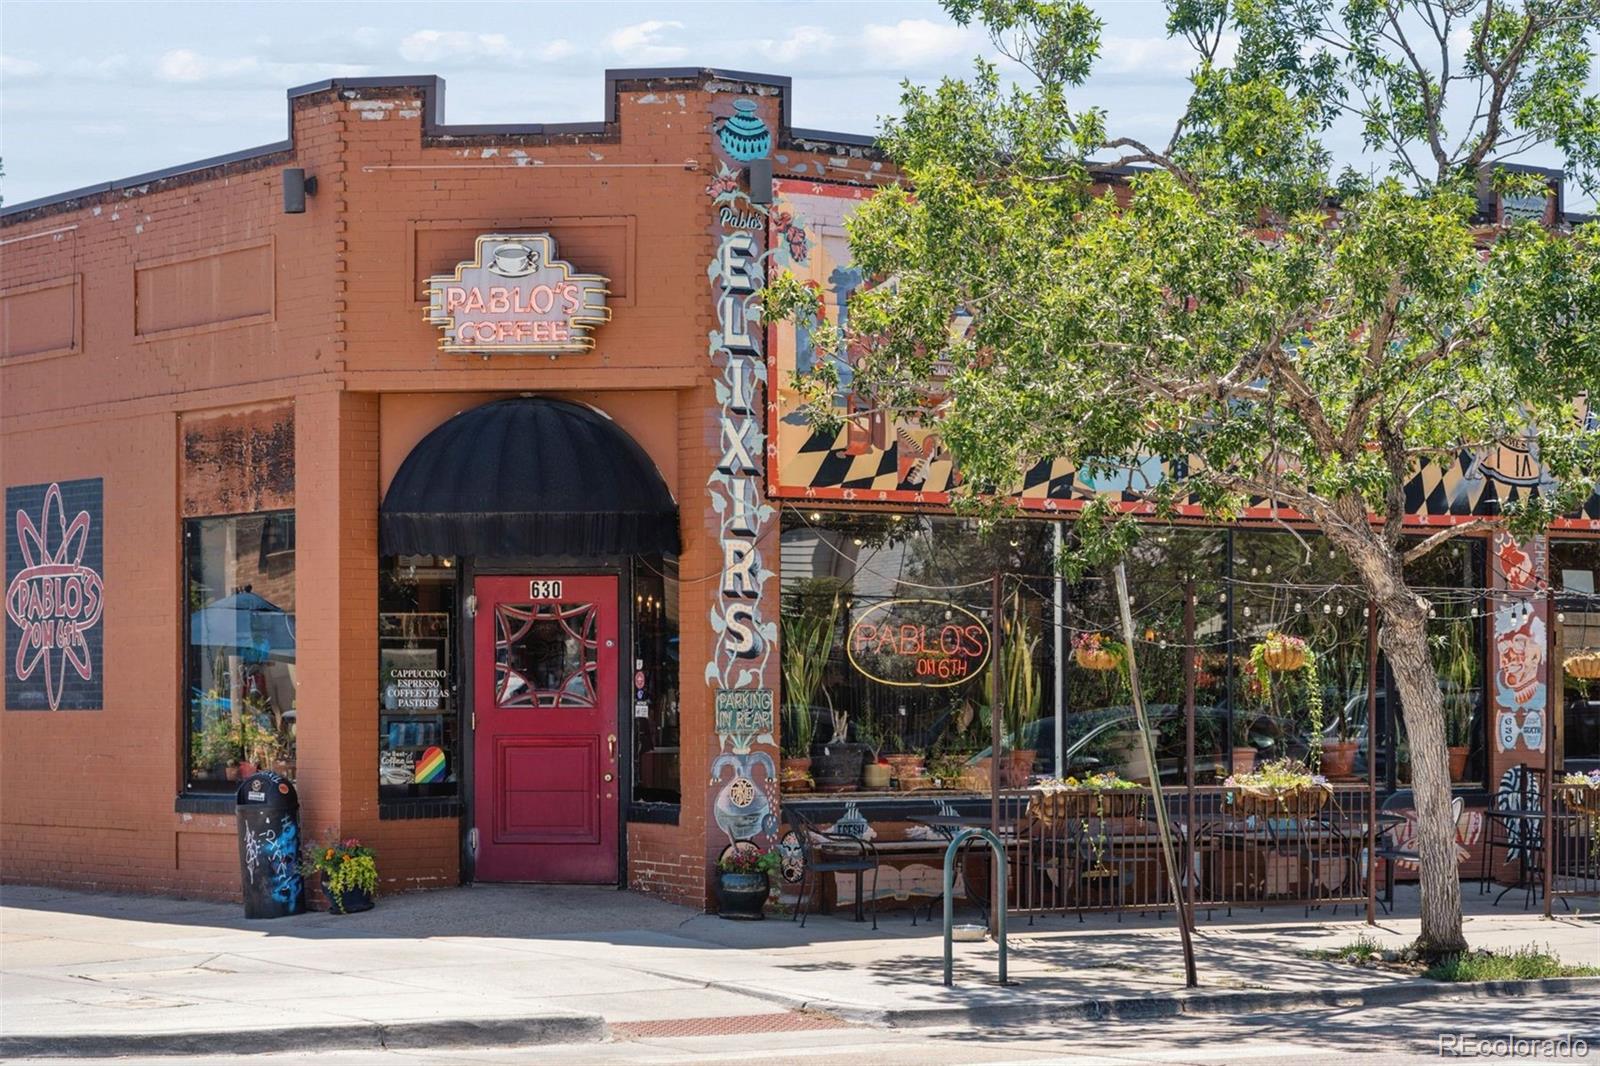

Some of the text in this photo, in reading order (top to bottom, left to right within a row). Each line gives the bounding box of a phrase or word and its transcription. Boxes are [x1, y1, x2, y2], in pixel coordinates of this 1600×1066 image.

[720, 206, 763, 230] Pablo's
[446, 281, 580, 315] PABLO'S
[457, 320, 569, 344] COFFEE
[720, 235, 762, 659] ELIXIRS
[18, 570, 97, 619] PABLO'S
[531, 581, 561, 598] 630
[32, 620, 54, 648] ON
[855, 624, 984, 657] PABLO'S
[390, 669, 448, 679] CAPPUCCINO
[917, 659, 968, 679] ON 6TH
[387, 688, 450, 698] COFFEES/TEAS
[397, 679, 440, 688] ESPRESSO
[398, 698, 439, 708] PASTRIES
[719, 692, 771, 709] PARKING
[719, 710, 770, 729] IN REAR
